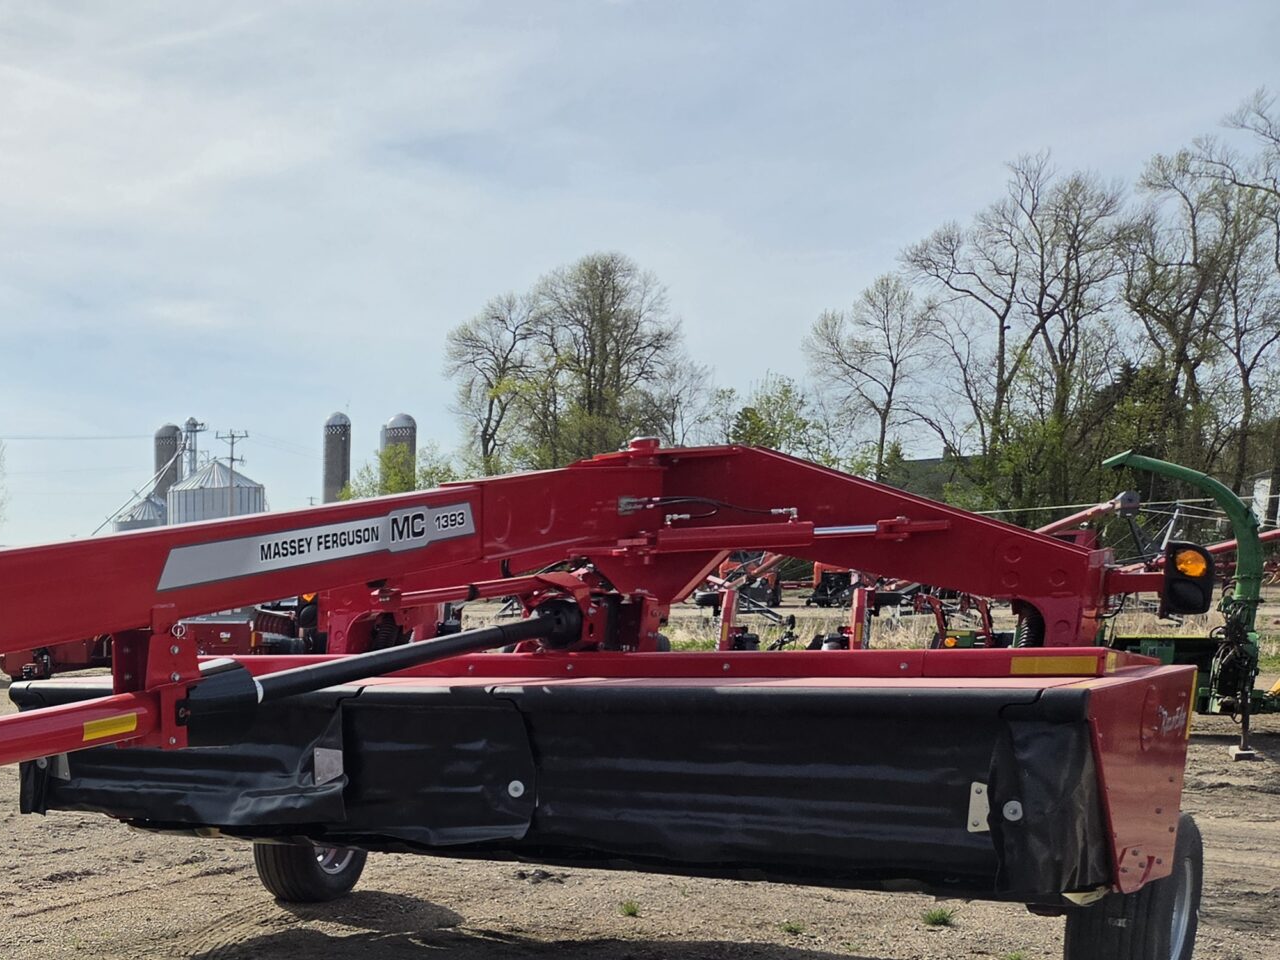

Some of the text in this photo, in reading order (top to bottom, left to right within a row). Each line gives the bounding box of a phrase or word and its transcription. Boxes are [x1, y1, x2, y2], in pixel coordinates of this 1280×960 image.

[260, 511, 465, 561] MASSEY FERGUSON MC 1393
